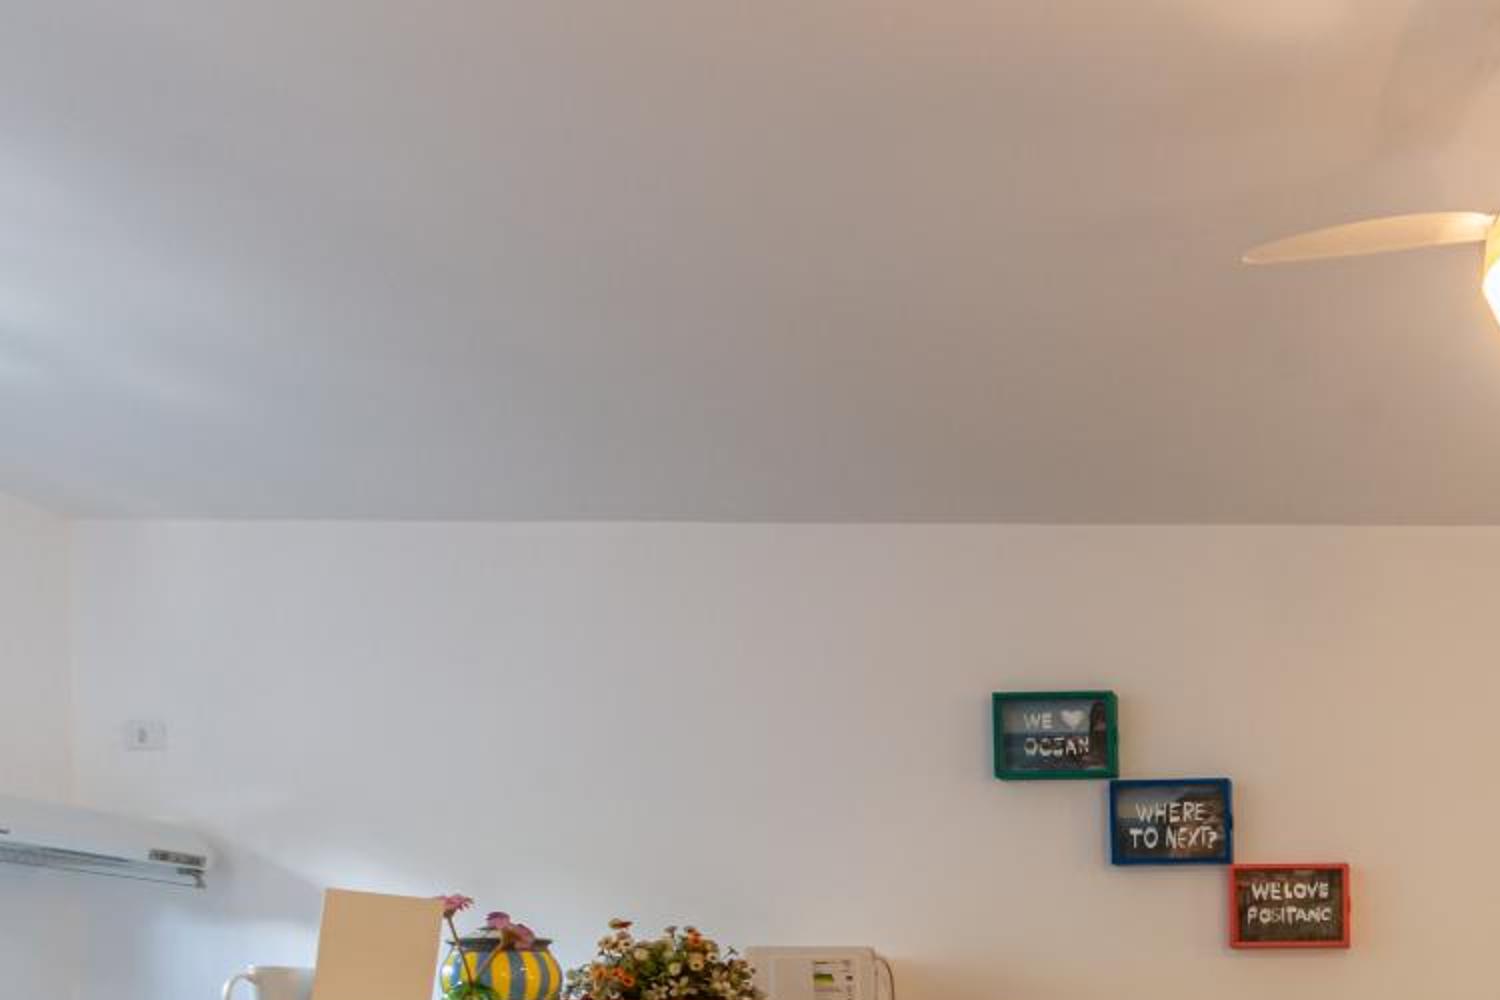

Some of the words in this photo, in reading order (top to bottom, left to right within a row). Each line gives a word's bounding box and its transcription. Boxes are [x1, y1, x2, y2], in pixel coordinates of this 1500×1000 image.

[1024, 712, 1053, 729] WE
[1024, 736, 1089, 757] OCEAN
[1136, 802, 1206, 823] WHERE
[1129, 827, 1159, 849] TO
[1165, 826, 1217, 849] NEXT?
[1251, 882, 1282, 900] WE
[1283, 881, 1329, 899] LOVE
